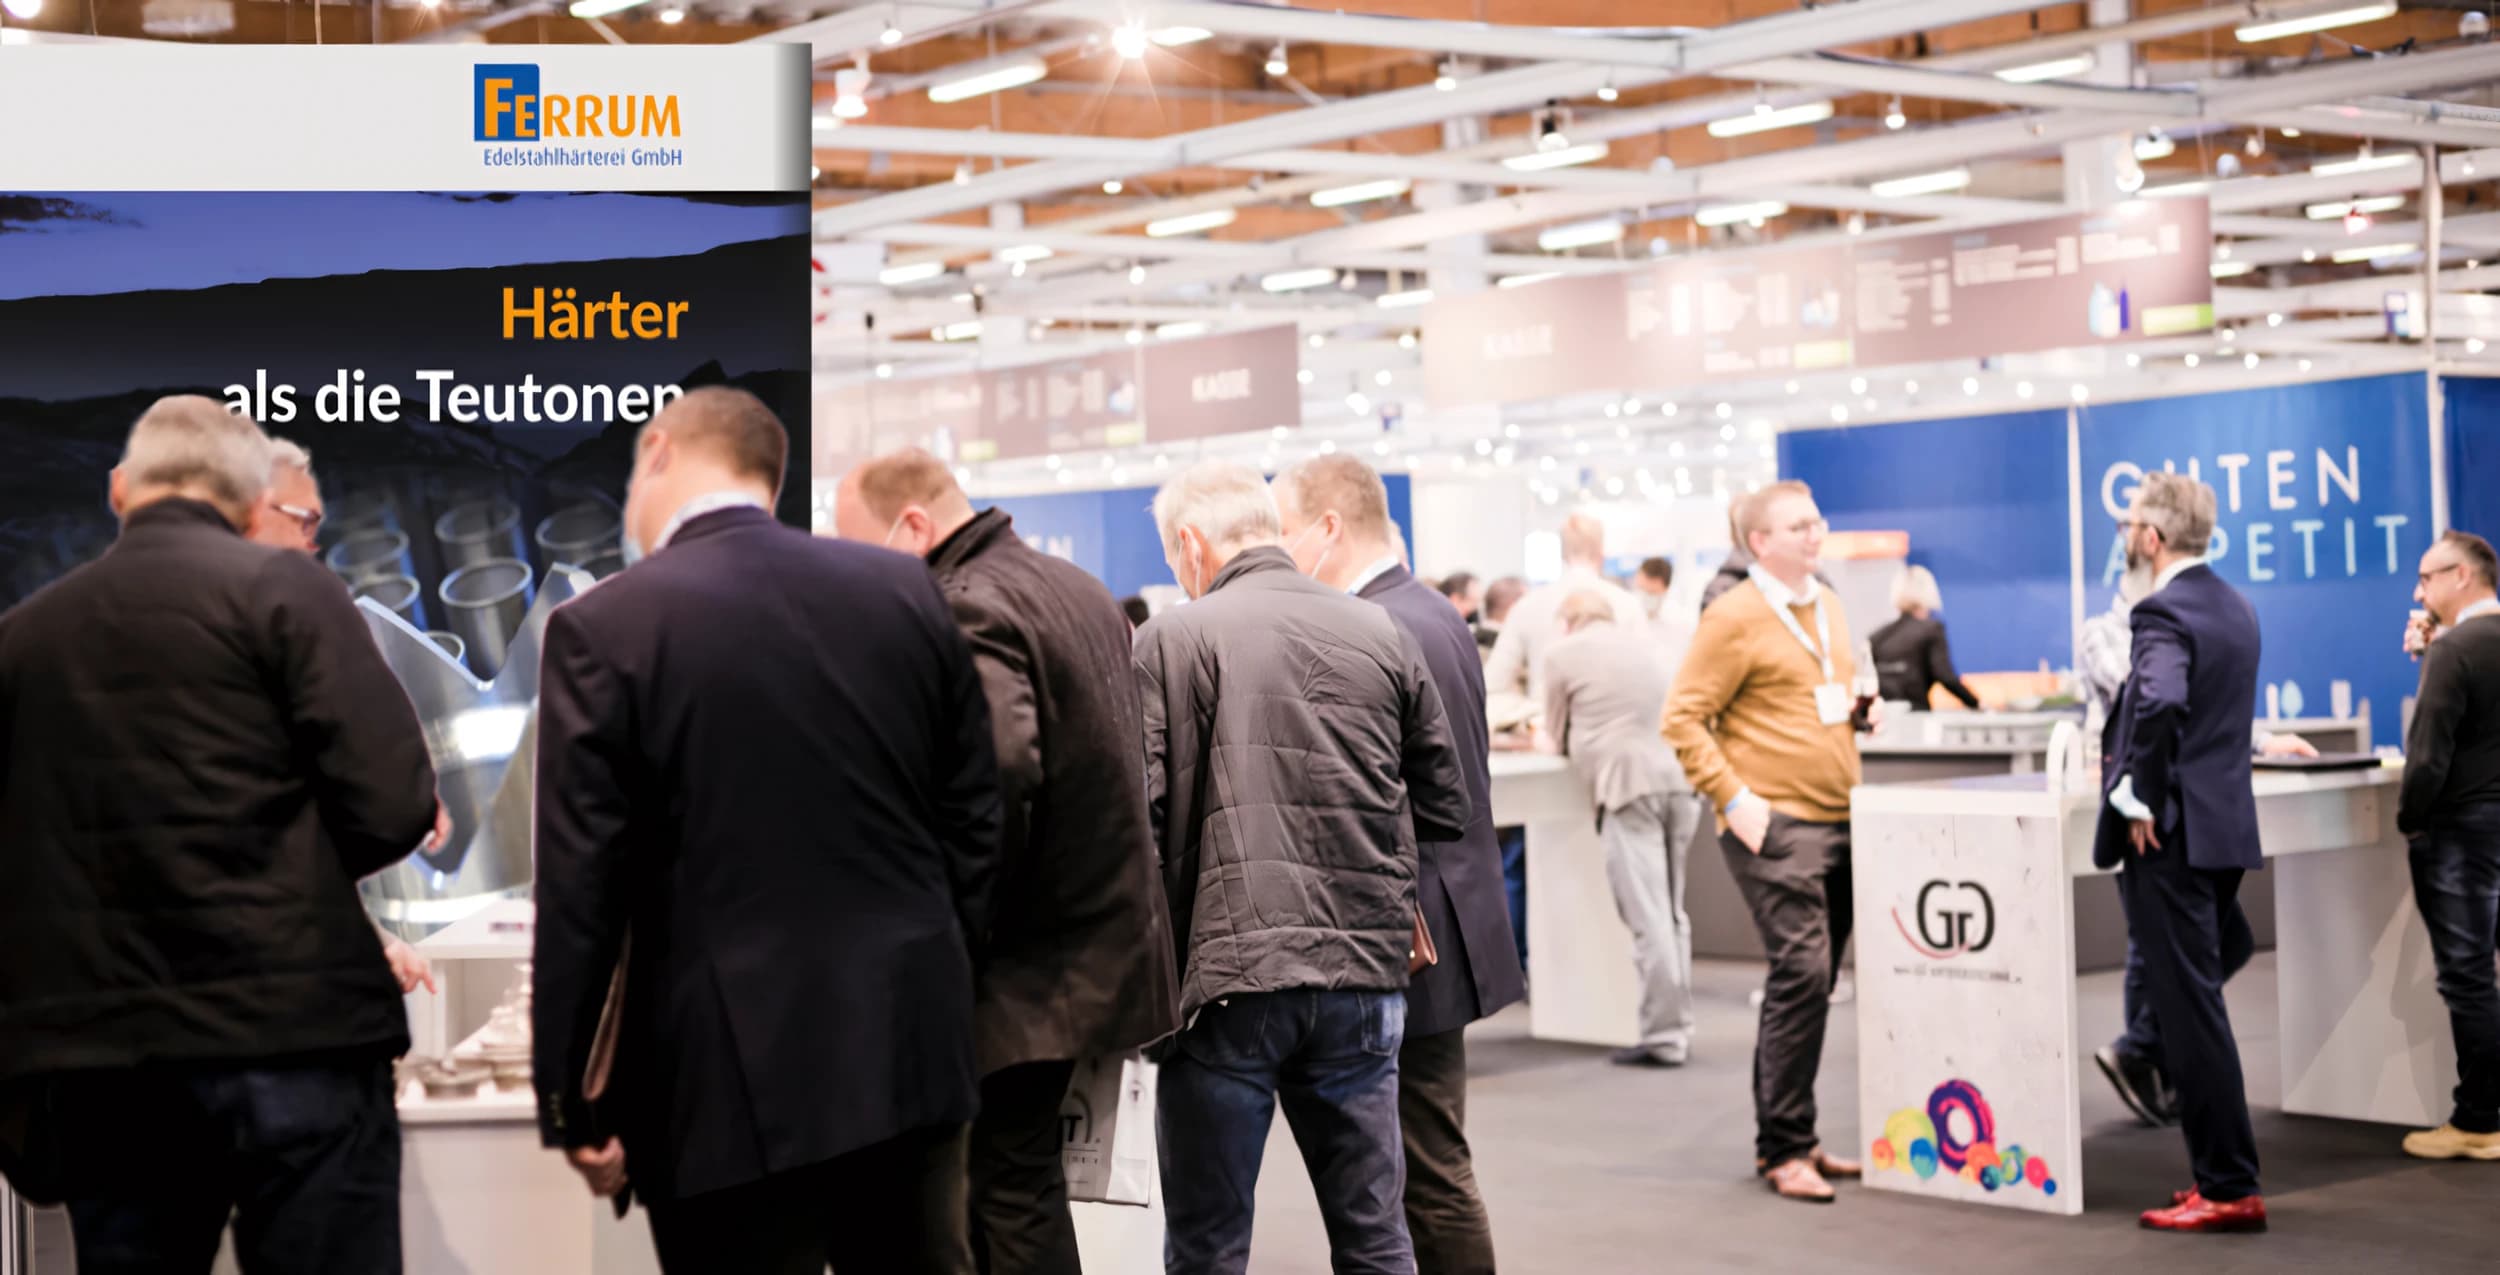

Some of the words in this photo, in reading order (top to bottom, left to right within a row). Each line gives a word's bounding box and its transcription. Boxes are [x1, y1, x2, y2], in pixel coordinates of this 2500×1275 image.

[484, 78, 681, 137] FERRUM
[484, 147, 626, 166] Edelstahlhärterei
[631, 147, 682, 166] GmbH
[503, 287, 689, 339] Härter
[223, 369, 297, 423] als
[314, 368, 400, 423] die
[2101, 445, 2361, 521] GTEN
